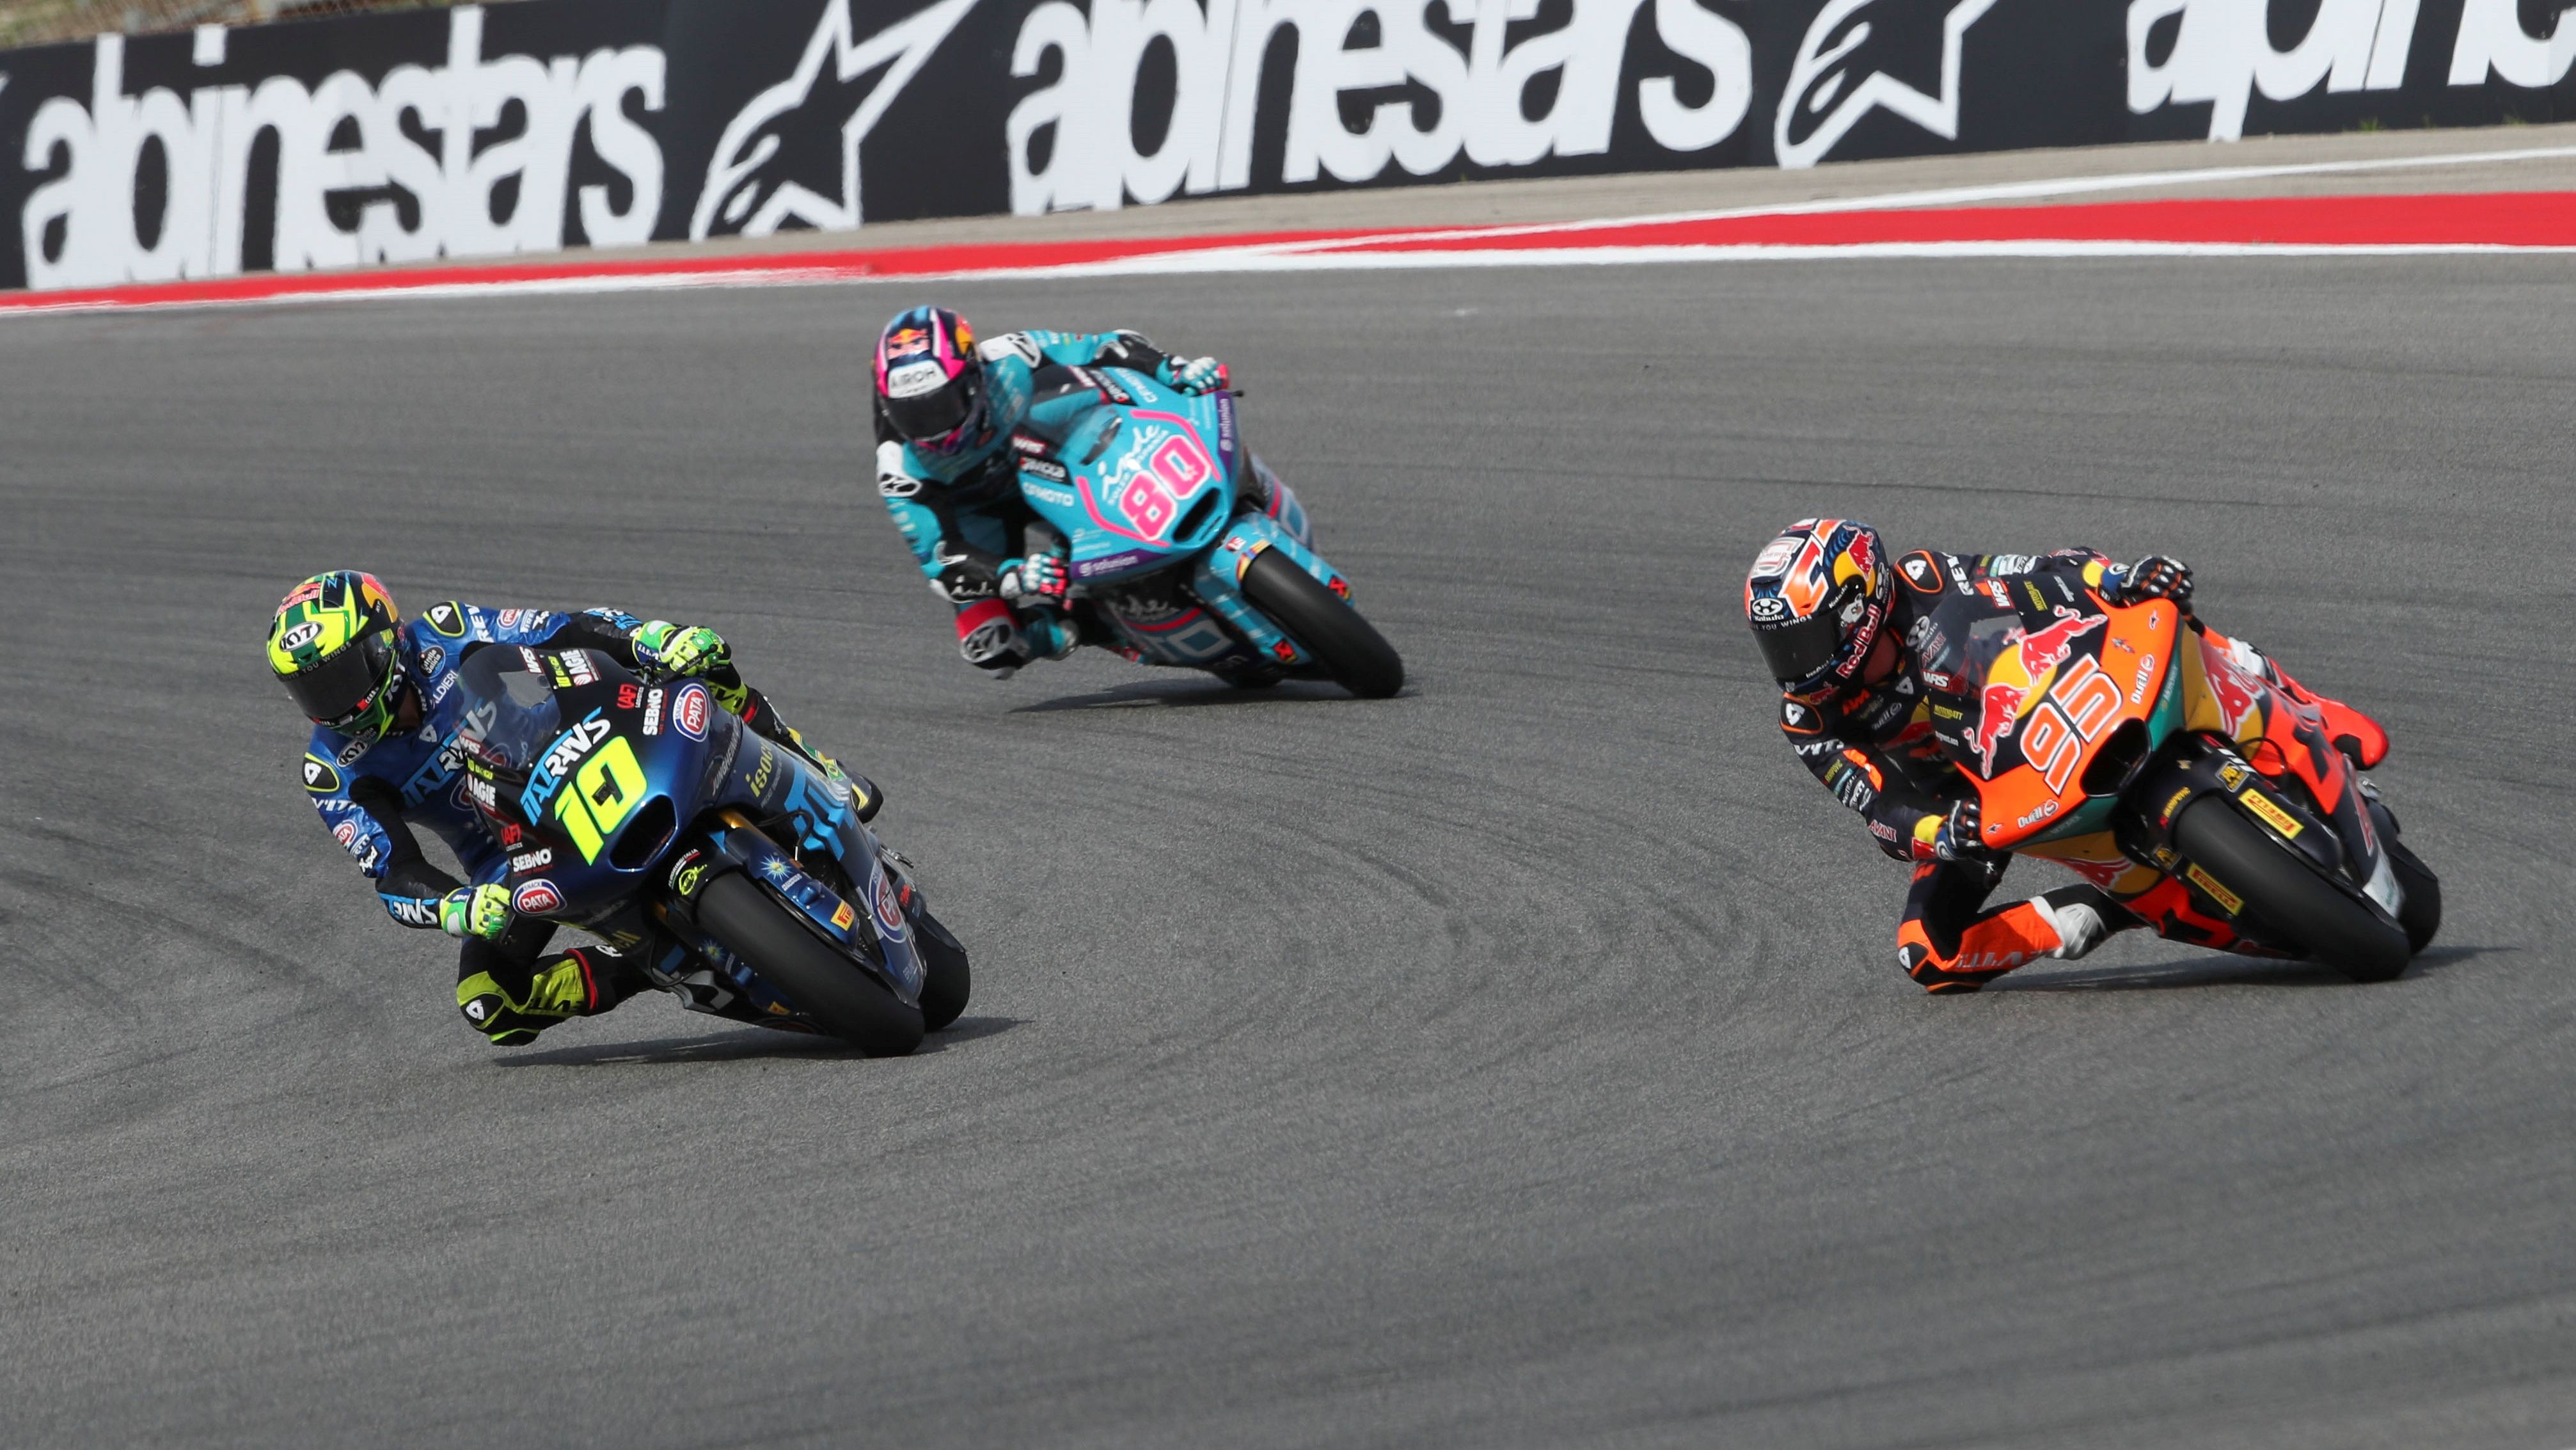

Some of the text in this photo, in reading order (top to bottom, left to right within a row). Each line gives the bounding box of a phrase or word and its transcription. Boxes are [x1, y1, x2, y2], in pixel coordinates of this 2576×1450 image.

[22, 3, 667, 291] alpinestars
[1119, 434, 1211, 541] 80
[1987, 580, 2011, 607] WRS
[281, 625, 313, 651] KYT
[1922, 632, 1947, 667] AVANT
[302, 663, 319, 673] YOU
[322, 641, 352, 663] WINGS
[519, 646, 542, 673] WRS
[1923, 671, 1950, 689] WRS
[687, 696, 704, 729] PATA
[2020, 653, 2124, 797] 95
[554, 735, 647, 866] 10
[2247, 794, 2296, 832] PIRELLI
[1869, 819, 1897, 843] AVANT
[522, 895, 551, 912] PATA
